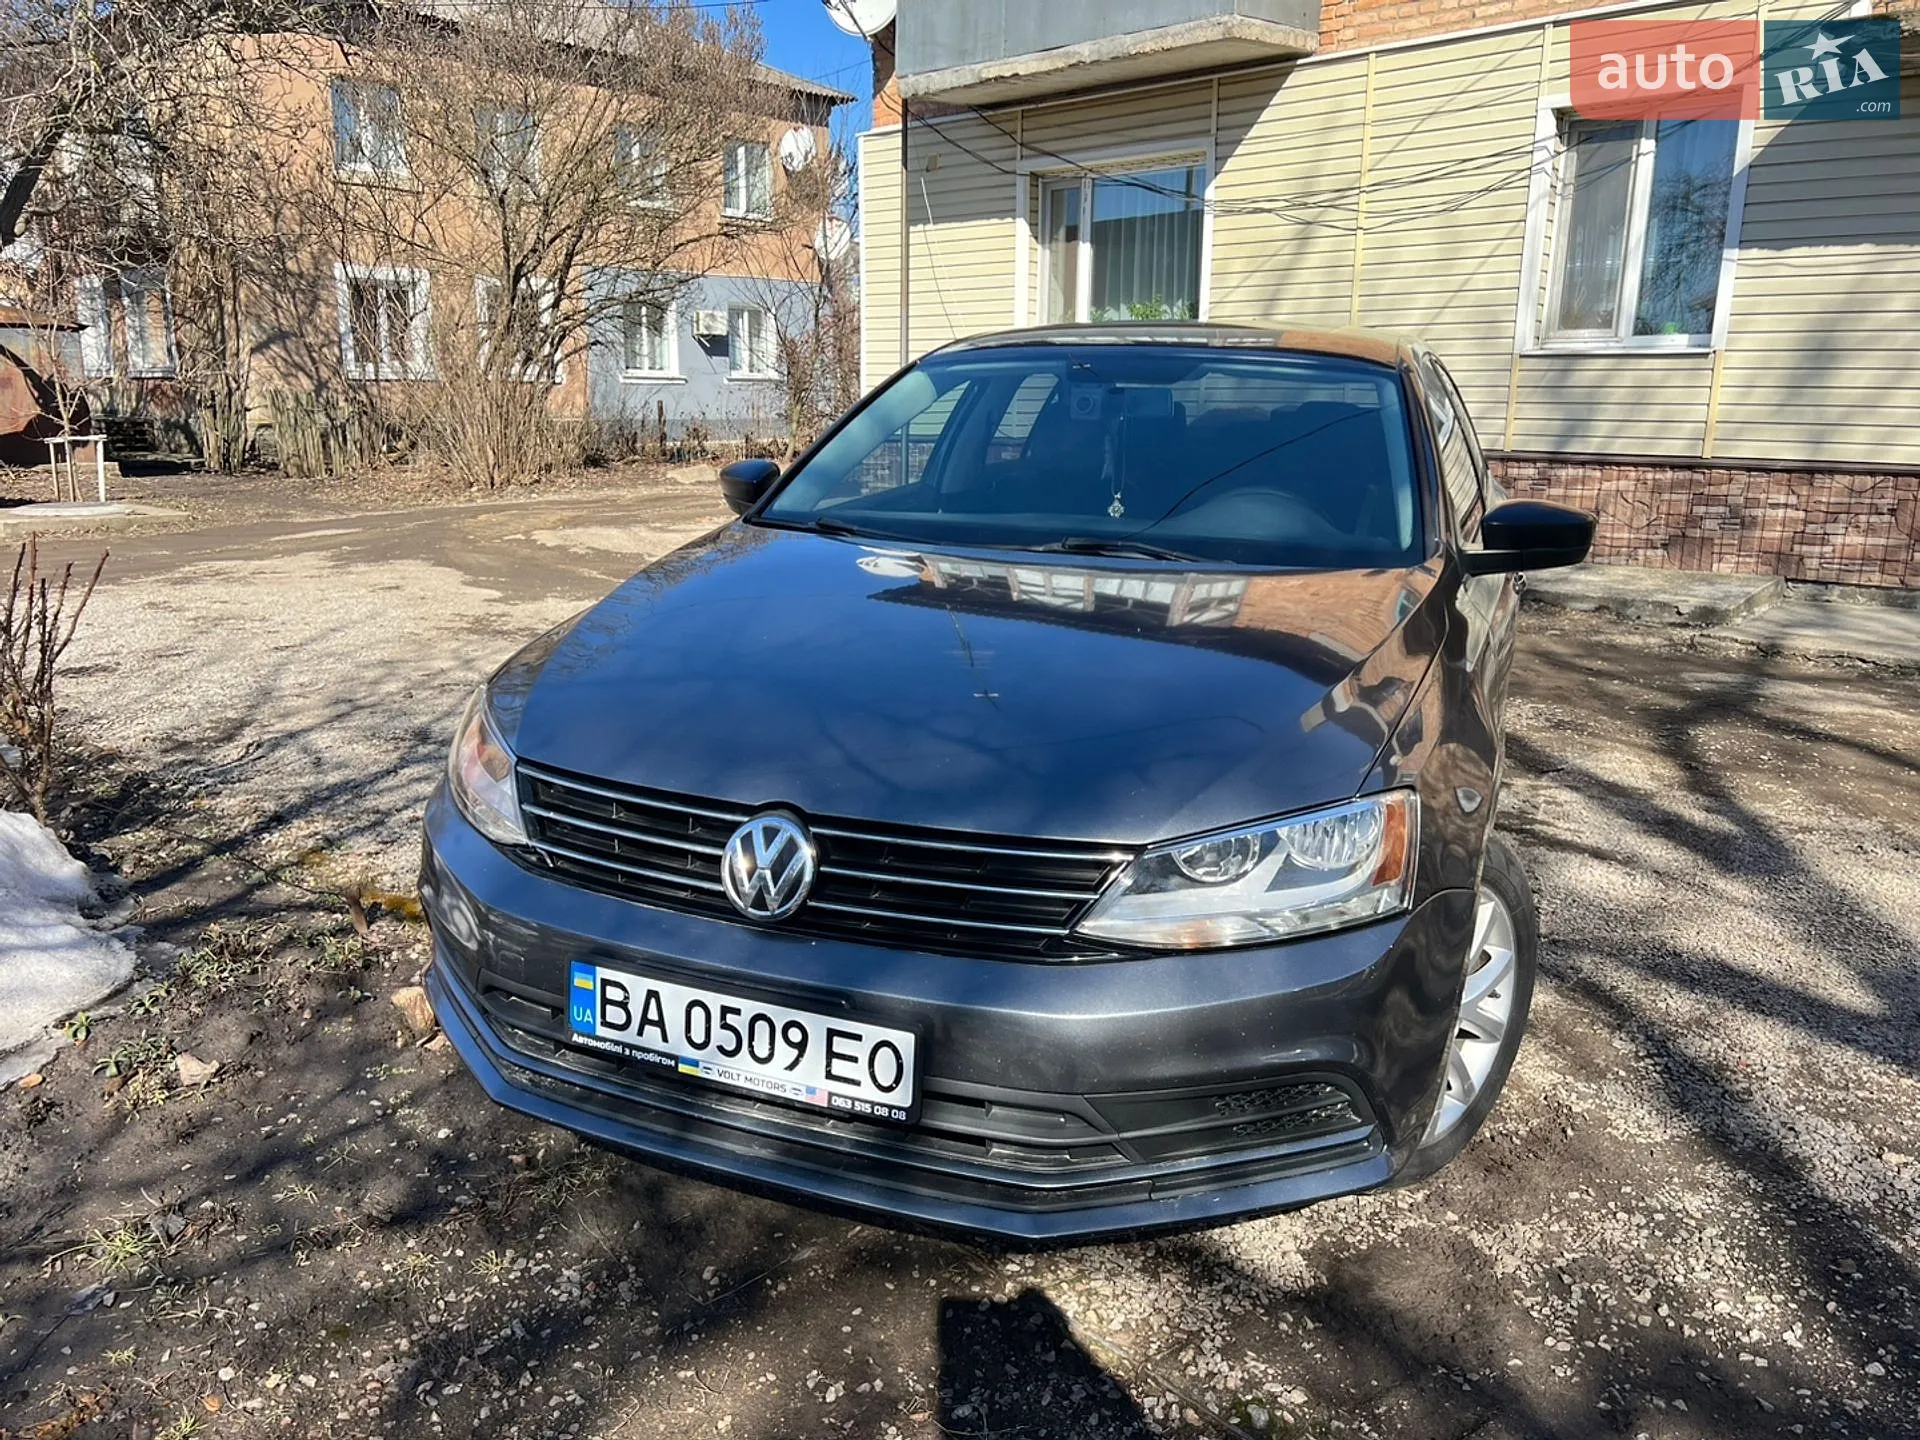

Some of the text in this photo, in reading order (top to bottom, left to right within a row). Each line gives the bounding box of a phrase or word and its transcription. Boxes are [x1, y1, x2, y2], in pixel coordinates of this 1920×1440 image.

[574, 1005, 594, 1024] UA
[600, 977, 904, 1094] BA 0509 EO
[717, 1069, 787, 1093] VOLT MOTORS
[831, 1096, 907, 1121] 063 515 08 08
